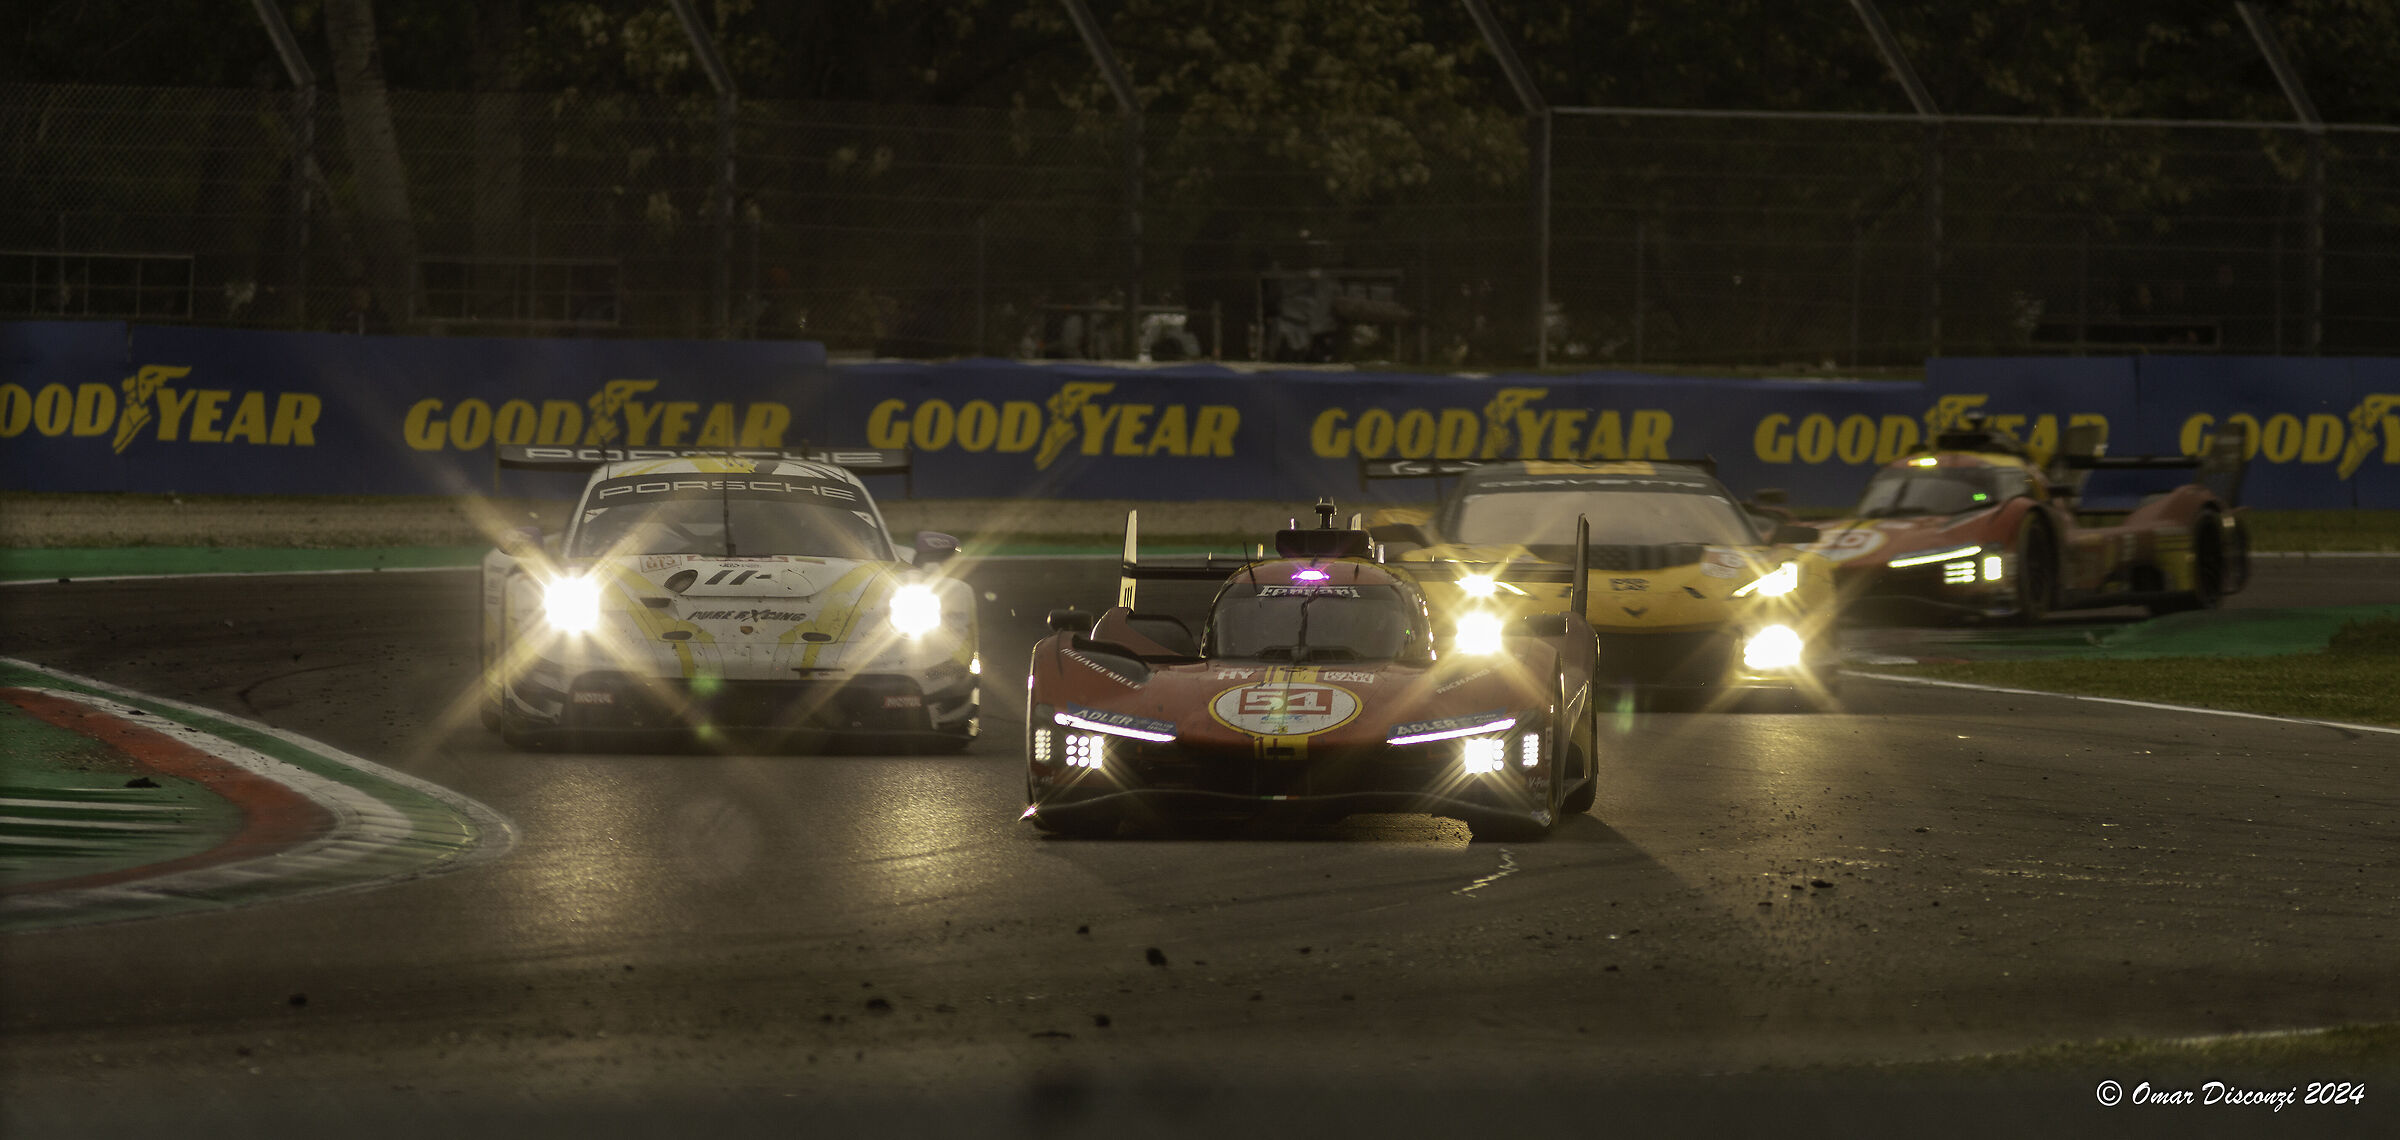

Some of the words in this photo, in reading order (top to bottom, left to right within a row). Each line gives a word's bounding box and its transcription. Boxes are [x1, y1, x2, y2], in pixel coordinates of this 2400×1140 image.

[404, 398, 791, 451] GOODYEAR
[867, 398, 1241, 457] GOODYEAR
[1311, 407, 1674, 460] GOODYEAR
[600, 480, 857, 502] PORSCHE
[1244, 690, 1327, 712] 51
[1073, 708, 1135, 727] ADLER
[1395, 717, 1459, 737] ADLER
